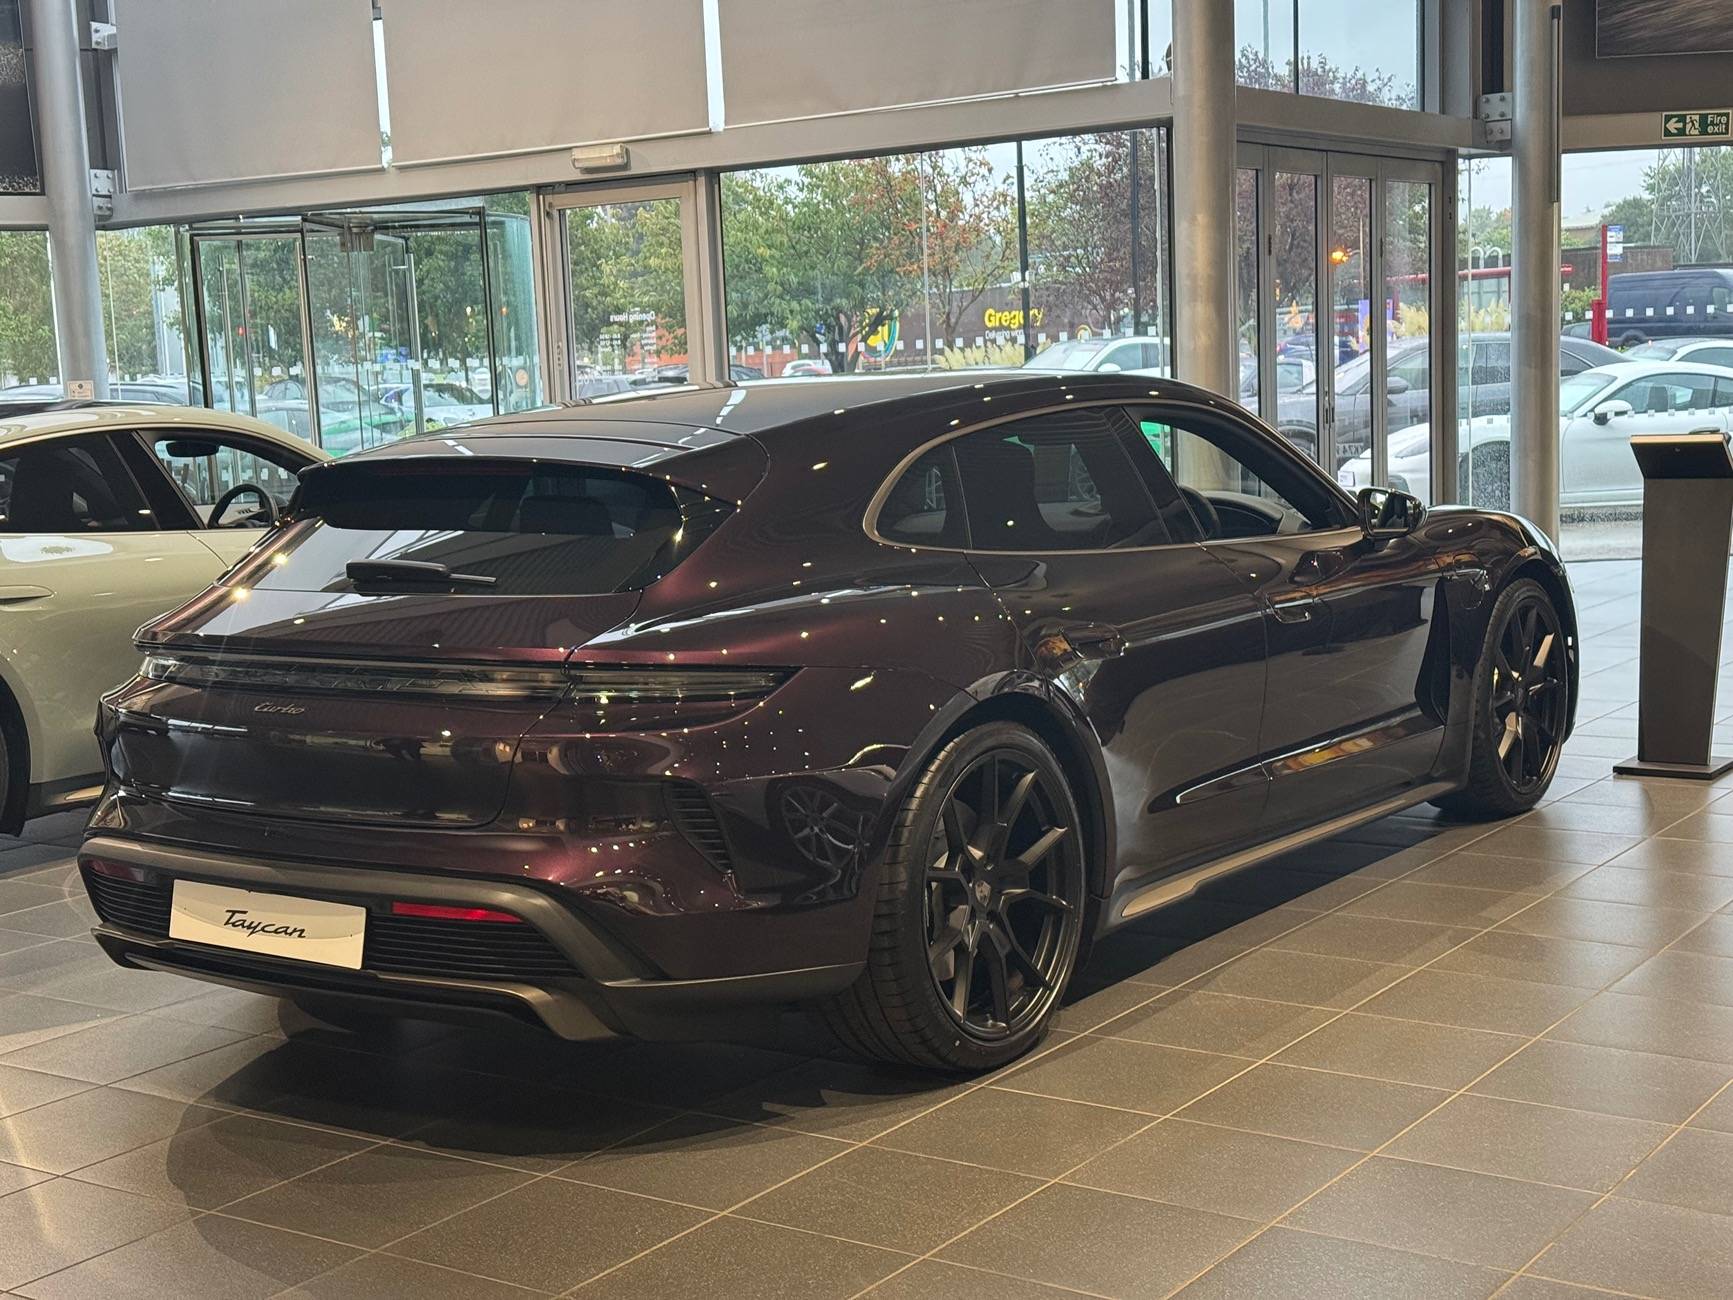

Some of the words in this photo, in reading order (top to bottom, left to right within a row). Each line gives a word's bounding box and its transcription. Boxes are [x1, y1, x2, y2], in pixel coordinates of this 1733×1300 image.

[1707, 114, 1728, 124] Fire
[1707, 123, 1726, 134] exit
[254, 702, 305, 714] turbo
[224, 909, 307, 938] Taycan
